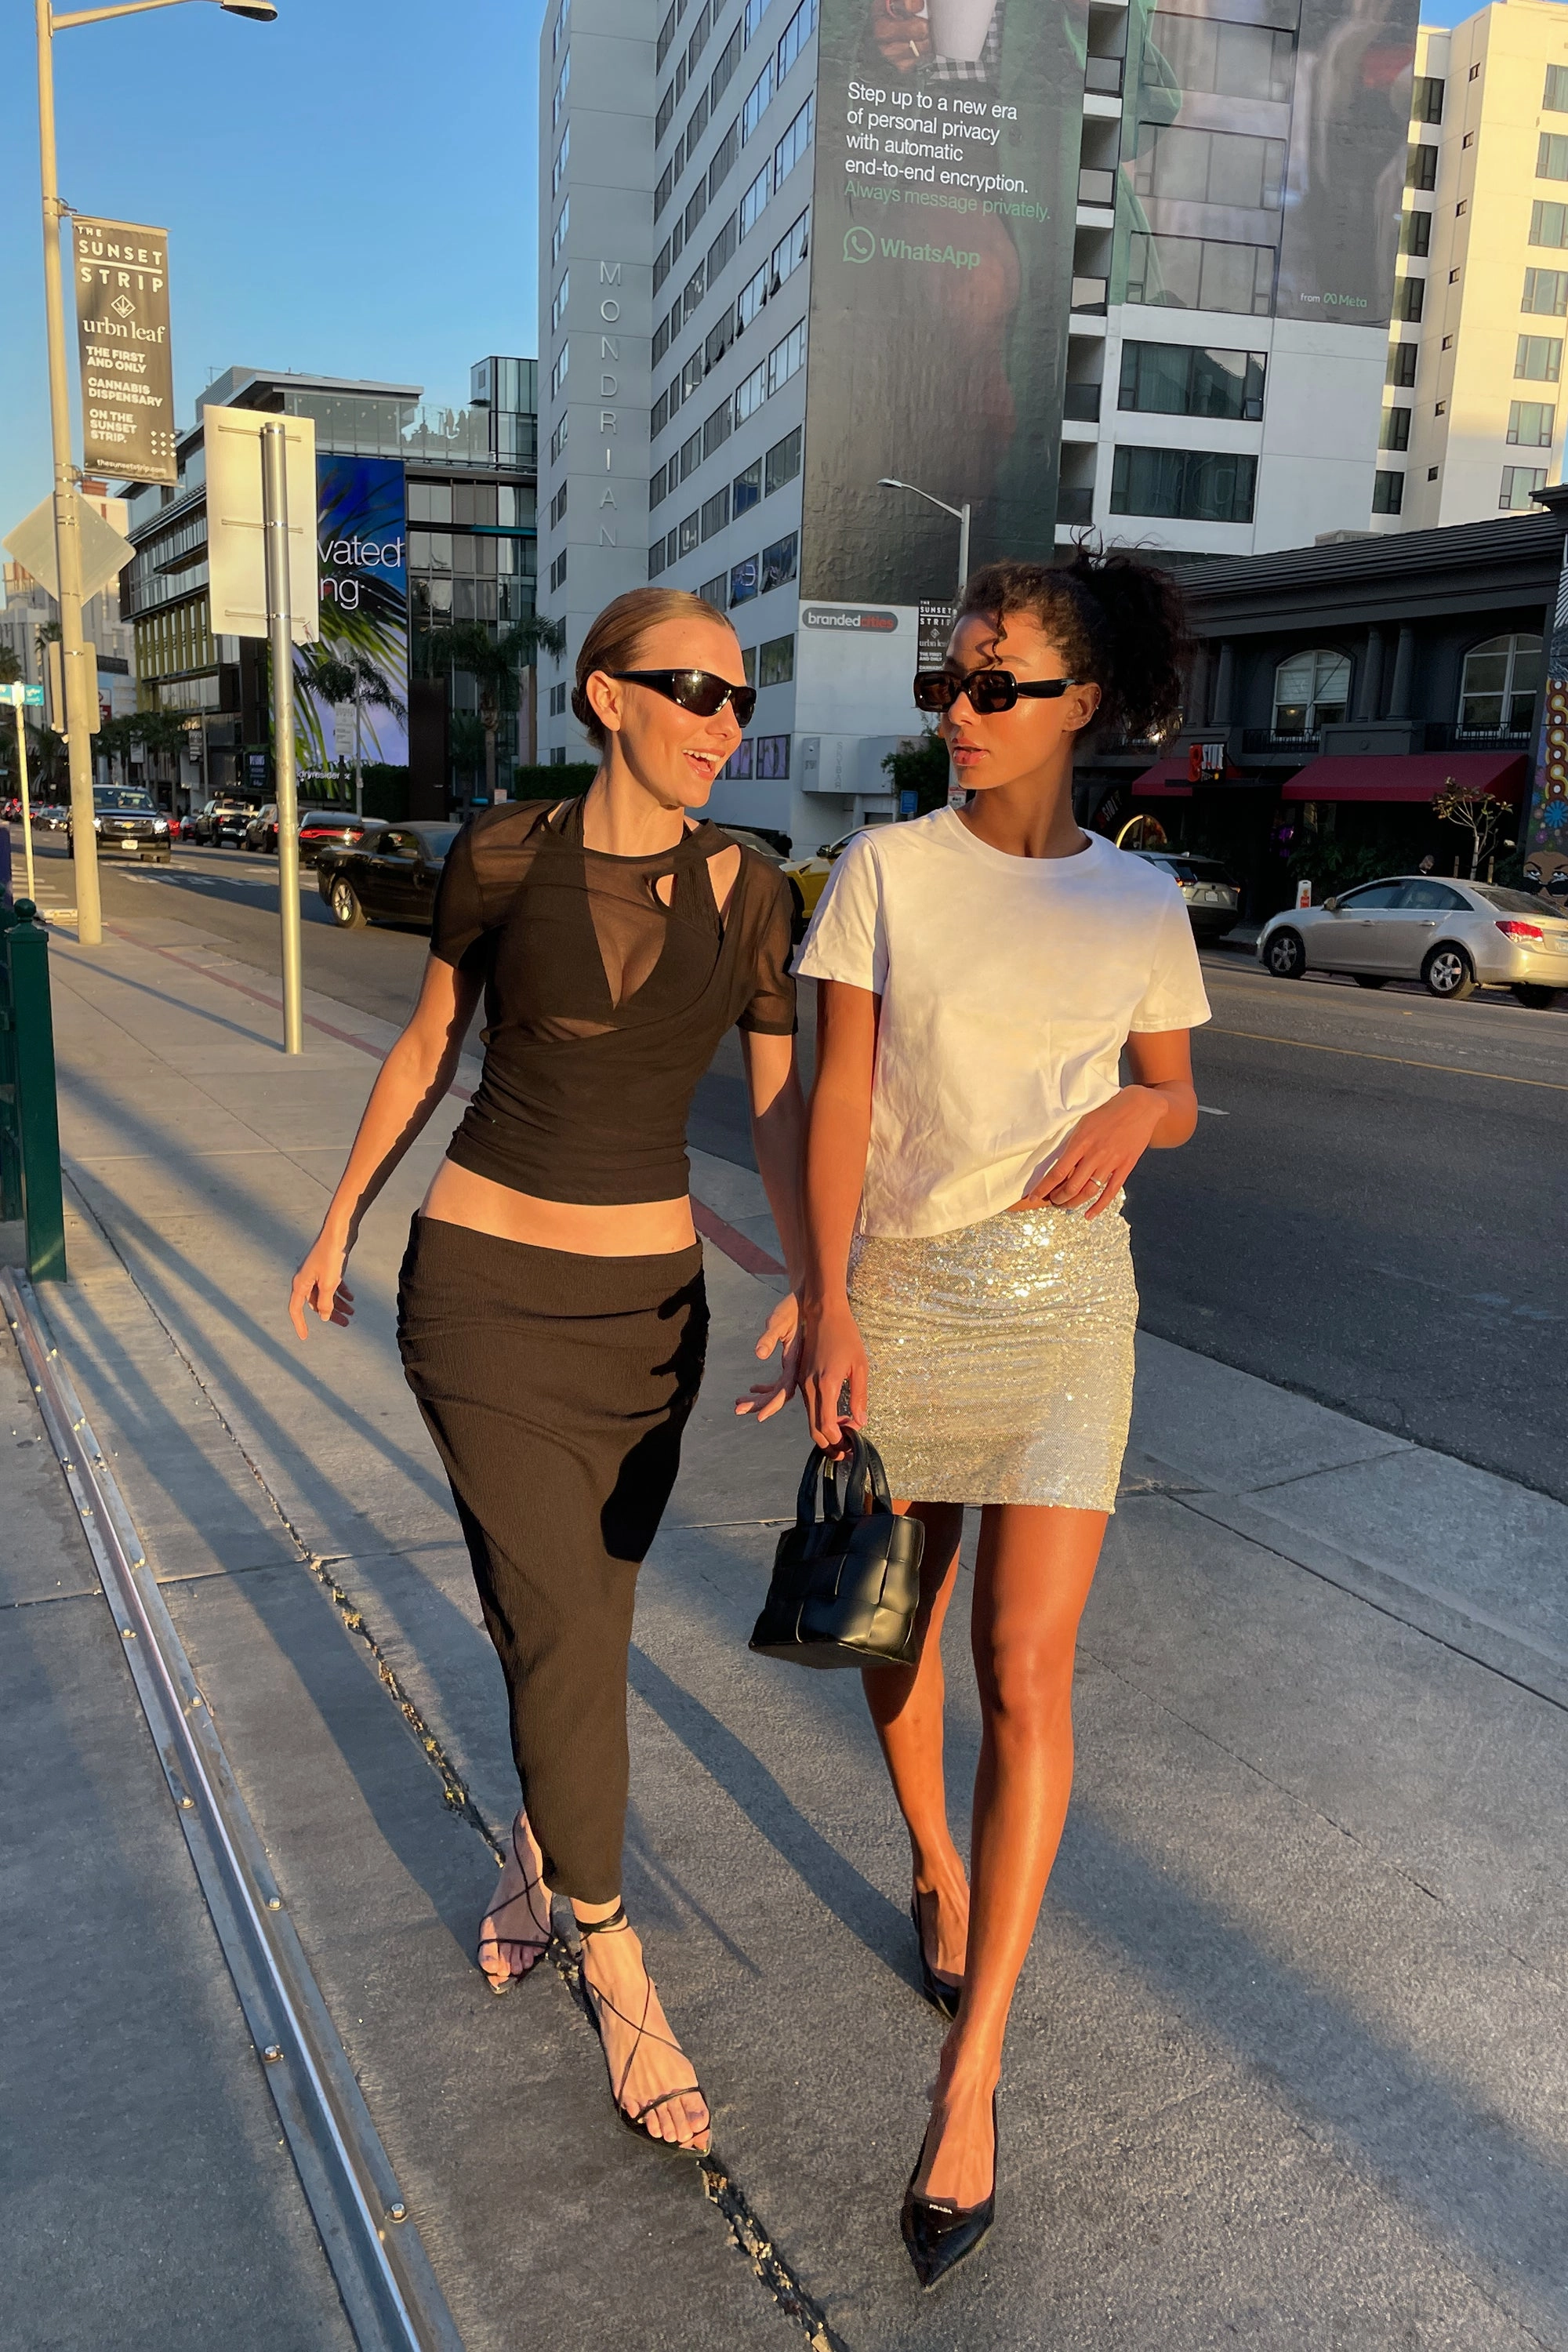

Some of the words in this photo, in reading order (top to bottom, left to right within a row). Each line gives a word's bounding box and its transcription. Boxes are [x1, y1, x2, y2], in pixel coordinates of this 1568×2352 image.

[848, 82, 886, 106] Step
[891, 91, 913, 110] up
[916, 91, 933, 109] to
[938, 98, 948, 111] a
[953, 99, 987, 115] new
[991, 104, 1018, 120] era
[847, 107, 864, 125] of
[868, 113, 937, 134] personal
[942, 121, 1000, 146] privacy
[846, 132, 880, 151] with
[884, 138, 964, 162] automatic
[845, 158, 935, 183] end-to-end
[939, 170, 1029, 194] encryption.
[844, 180, 901, 205] Always
[905, 190, 978, 214] message
[982, 198, 1051, 223] privately.
[78, 226, 102, 237] THE
[78, 239, 163, 266] SUNSET
[880, 238, 980, 270] WhatsApp
[80, 267, 164, 292] STRIP
[1300, 292, 1320, 303] from
[1338, 294, 1367, 308] Meta
[82, 316, 128, 338] urbn
[131, 321, 165, 344] leaf
[85, 345, 111, 358] THE
[112, 349, 146, 363] FIRST
[86, 357, 114, 368] AND
[114, 360, 147, 374] ONLY
[87, 377, 151, 395] CANNABIS
[88, 387, 163, 408] DISPENSARY
[89, 408, 107, 420] ON
[110, 411, 133, 423] THE
[598, 261, 622, 547] MONDRIAN
[89, 419, 137, 434] SUNSET
[90, 429, 128, 444] STRIP.
[96, 459, 167, 474] thesunsetstrip.com
